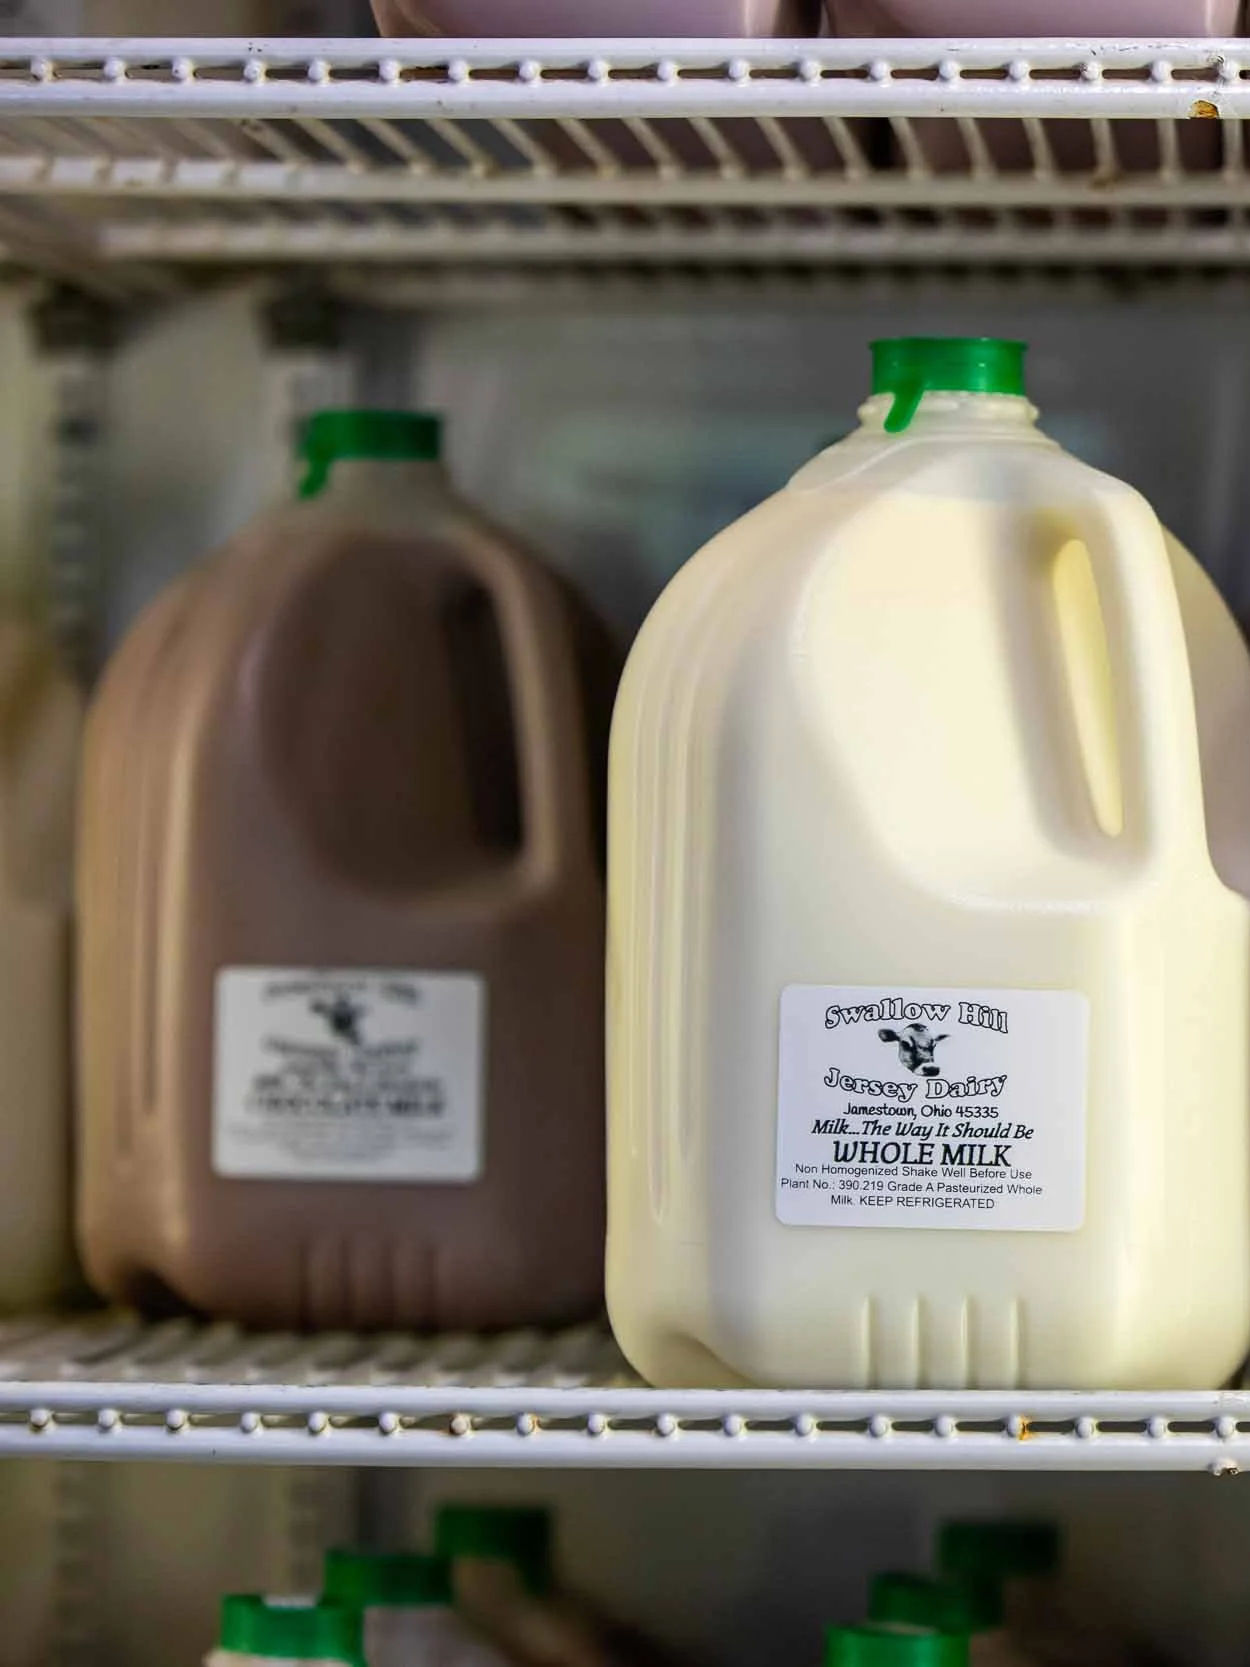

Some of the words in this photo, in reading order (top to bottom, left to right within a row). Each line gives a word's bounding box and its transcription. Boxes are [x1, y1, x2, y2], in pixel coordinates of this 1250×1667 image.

[824, 998, 950, 1029] Swallow
[958, 1002, 1009, 1034] Hill
[823, 1067, 918, 1102] Jersey
[926, 1075, 1008, 1099] Dairy
[843, 1102, 917, 1120] Jamestown,
[921, 1104, 952, 1118] Ohio
[955, 1105, 999, 1118] 45335
[895, 1121, 933, 1141] Way
[935, 1122, 950, 1137] It
[952, 1121, 1012, 1138] Should
[1013, 1124, 1034, 1139] Be
[833, 1140, 935, 1165] WHOLE
[940, 1143, 1012, 1167] MILK
[795, 1163, 818, 1174] Non
[821, 1164, 898, 1177] Homogenized
[902, 1166, 938, 1177] Shake
[941, 1167, 966, 1178] Well
[969, 1167, 1007, 1179] Before
[1010, 1169, 1032, 1180] Use
[780, 1177, 809, 1190] Plant
[839, 1180, 884, 1191] 390.219
[887, 1181, 923, 1192] Grade
[925, 1182, 935, 1192] A
[937, 1183, 1003, 1194] Pasteurized
[1006, 1184, 1043, 1195] Whole
[859, 1195, 893, 1206] KEEP
[896, 1196, 995, 1209] REFRIGERATED
